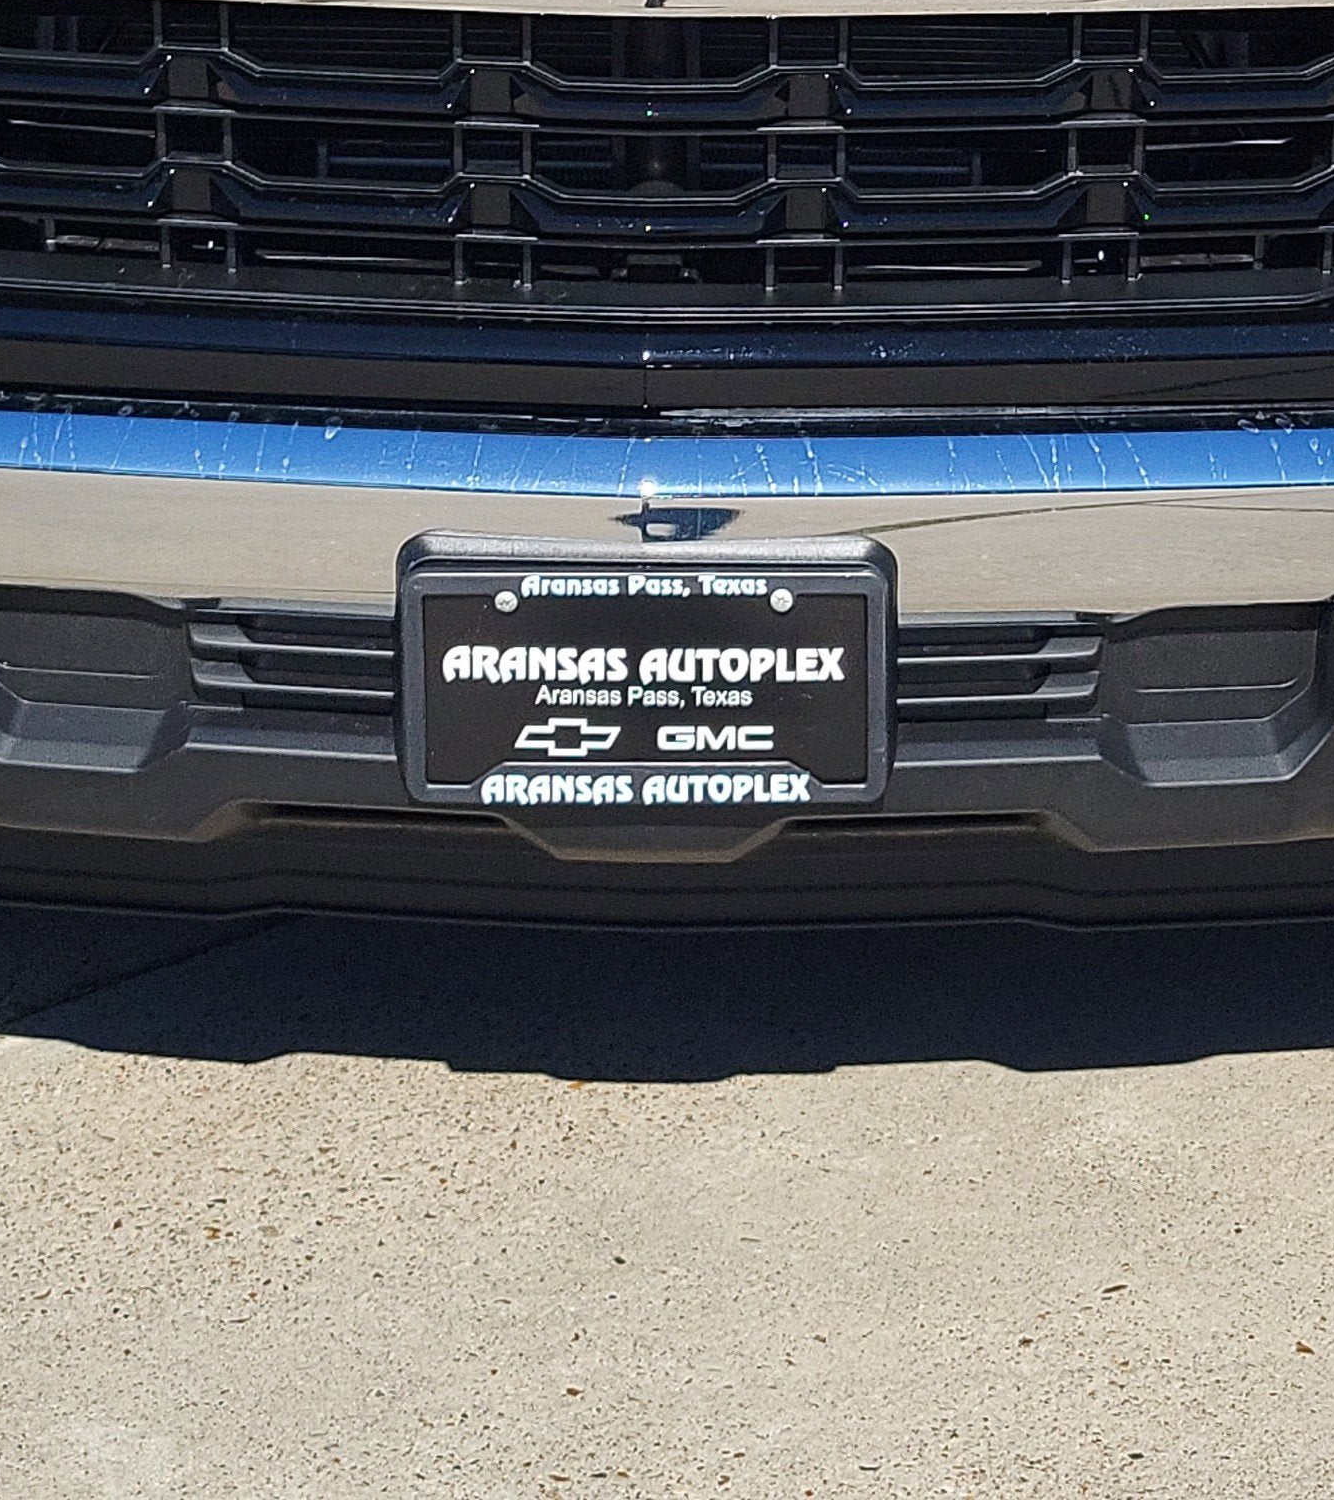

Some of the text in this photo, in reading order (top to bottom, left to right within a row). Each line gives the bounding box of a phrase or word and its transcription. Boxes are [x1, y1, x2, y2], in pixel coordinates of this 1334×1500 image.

[521, 574, 768, 598] Aransas Pass, Texas
[442, 645, 845, 686] ARANSAS AUTOPLEX
[535, 685, 753, 708] Aransas Pass, Texas
[657, 725, 774, 751] GMC
[480, 773, 811, 806] ARANSAS AUTOPLEX
